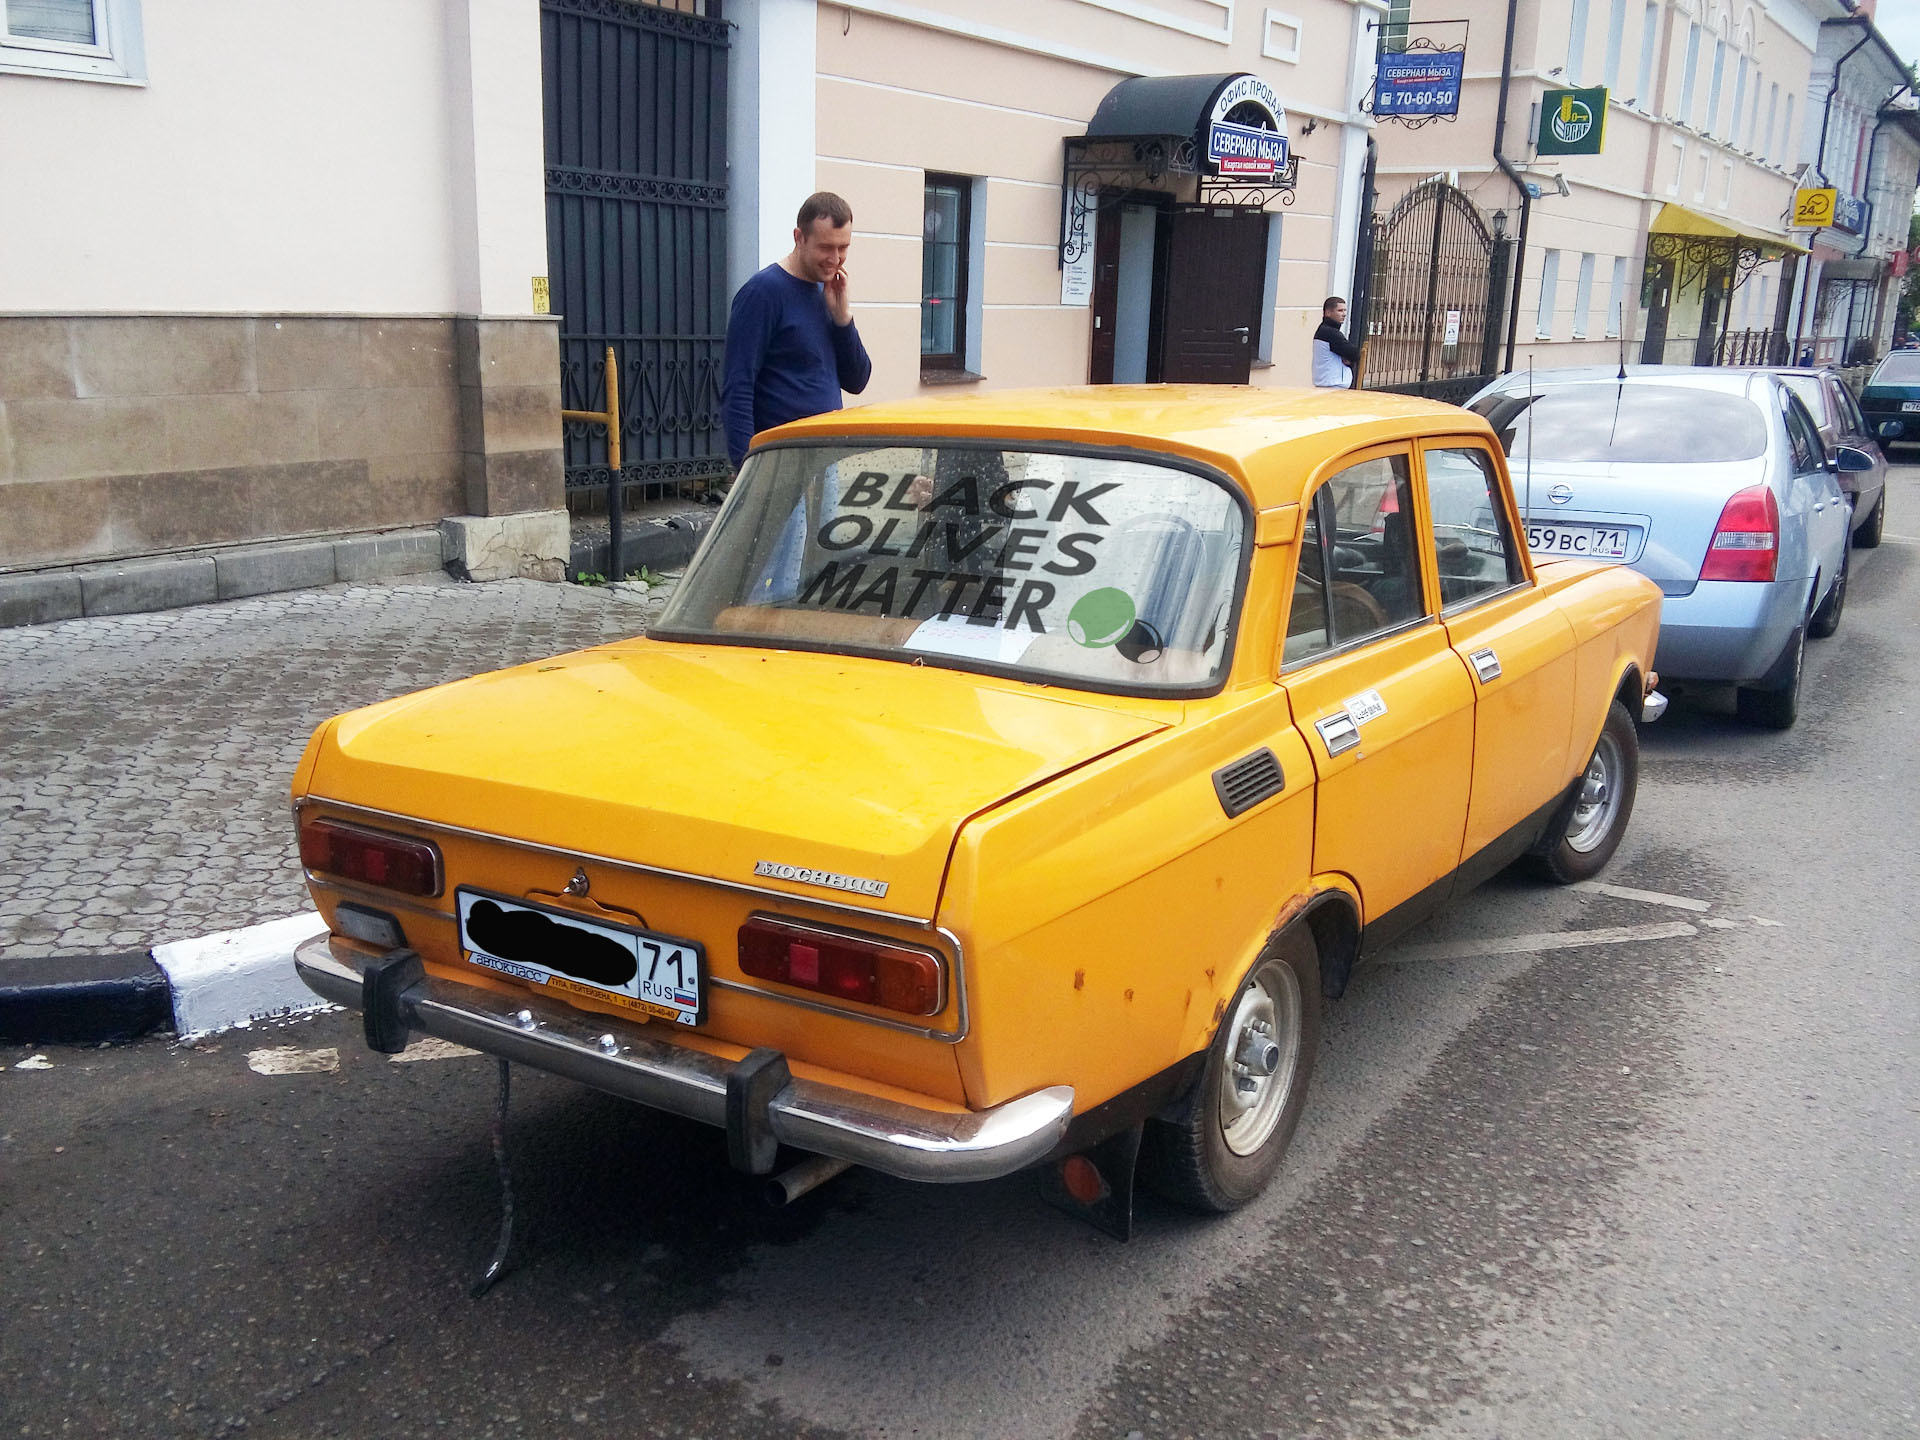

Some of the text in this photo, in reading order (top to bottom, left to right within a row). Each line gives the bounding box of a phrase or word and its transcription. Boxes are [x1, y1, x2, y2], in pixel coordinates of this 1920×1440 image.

[1387, 67, 1452, 78] СЕВЕРНАЯ МЫЗА
[1220, 80, 1284, 123] ОФИС ПРОДАЖ
[1396, 91, 1453, 106] 70-60-50
[1213, 131, 1284, 162] СЕВЕРНАЯ МЫЗА
[1798, 205, 1815, 216] 24
[838, 471, 1123, 526] BLACK
[817, 514, 1105, 576] OLIVES
[1596, 530, 1620, 548] 71
[798, 561, 1056, 634] MATTER
[476, 954, 542, 982] автокласс
[642, 942, 683, 988] 71
[643, 981, 673, 1001] RUS
